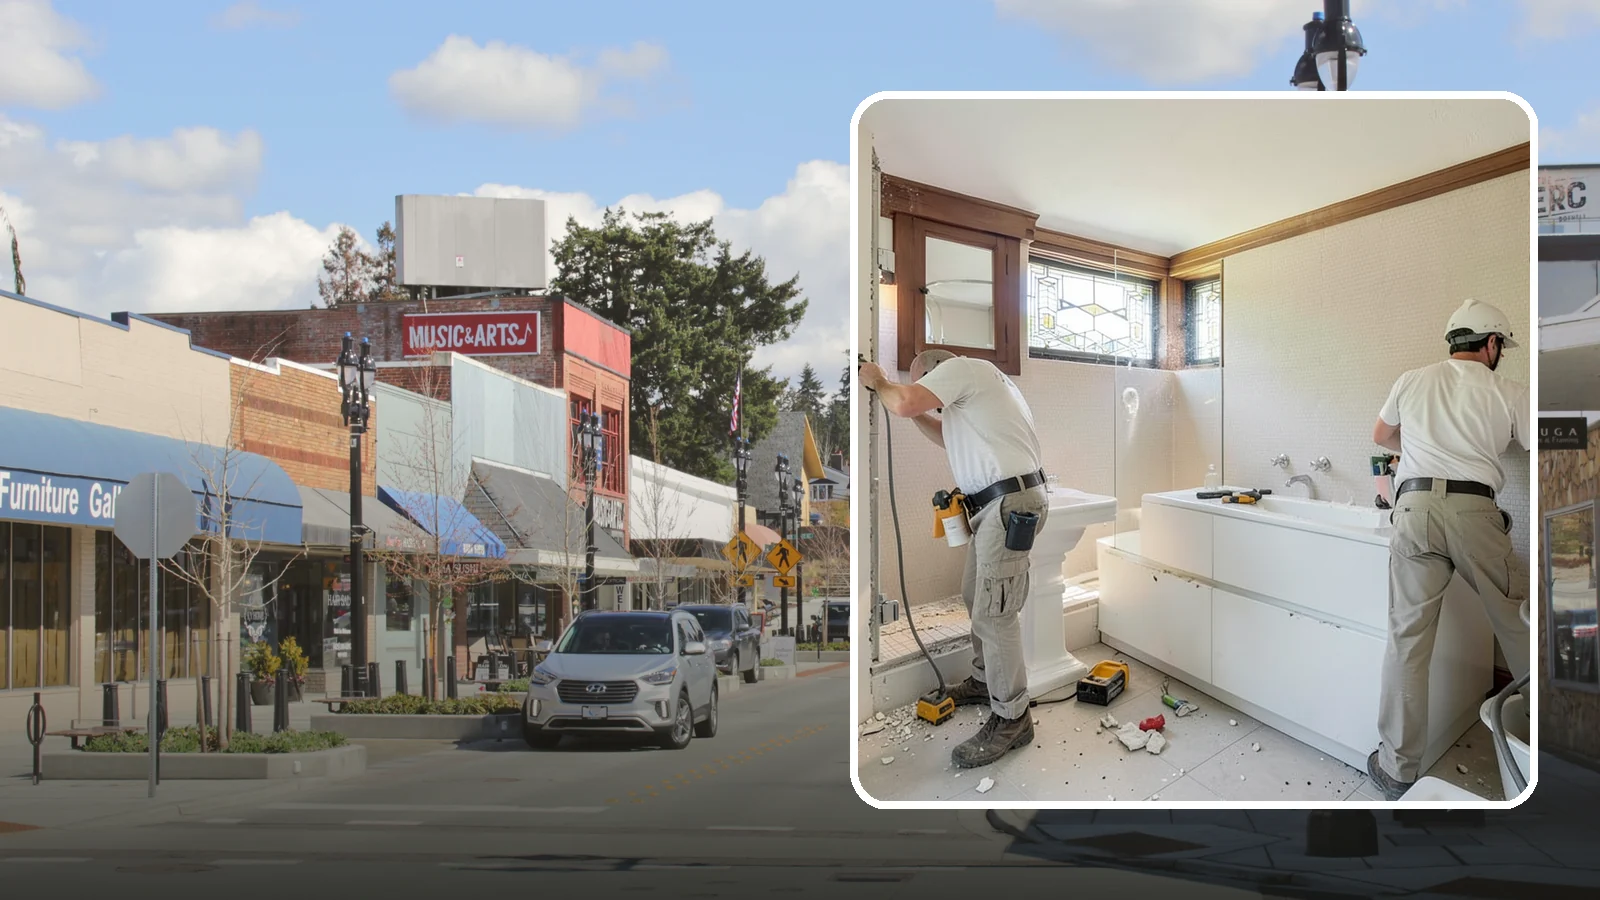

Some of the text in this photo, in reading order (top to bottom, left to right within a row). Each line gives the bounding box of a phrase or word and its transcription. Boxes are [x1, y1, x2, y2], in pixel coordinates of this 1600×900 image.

[409, 323, 520, 348] MUSIC&ARTS
[1540, 428, 1577, 437] UGA
[0, 472, 121, 519] Furniture Gal
[453, 563, 479, 574] SUSHI
